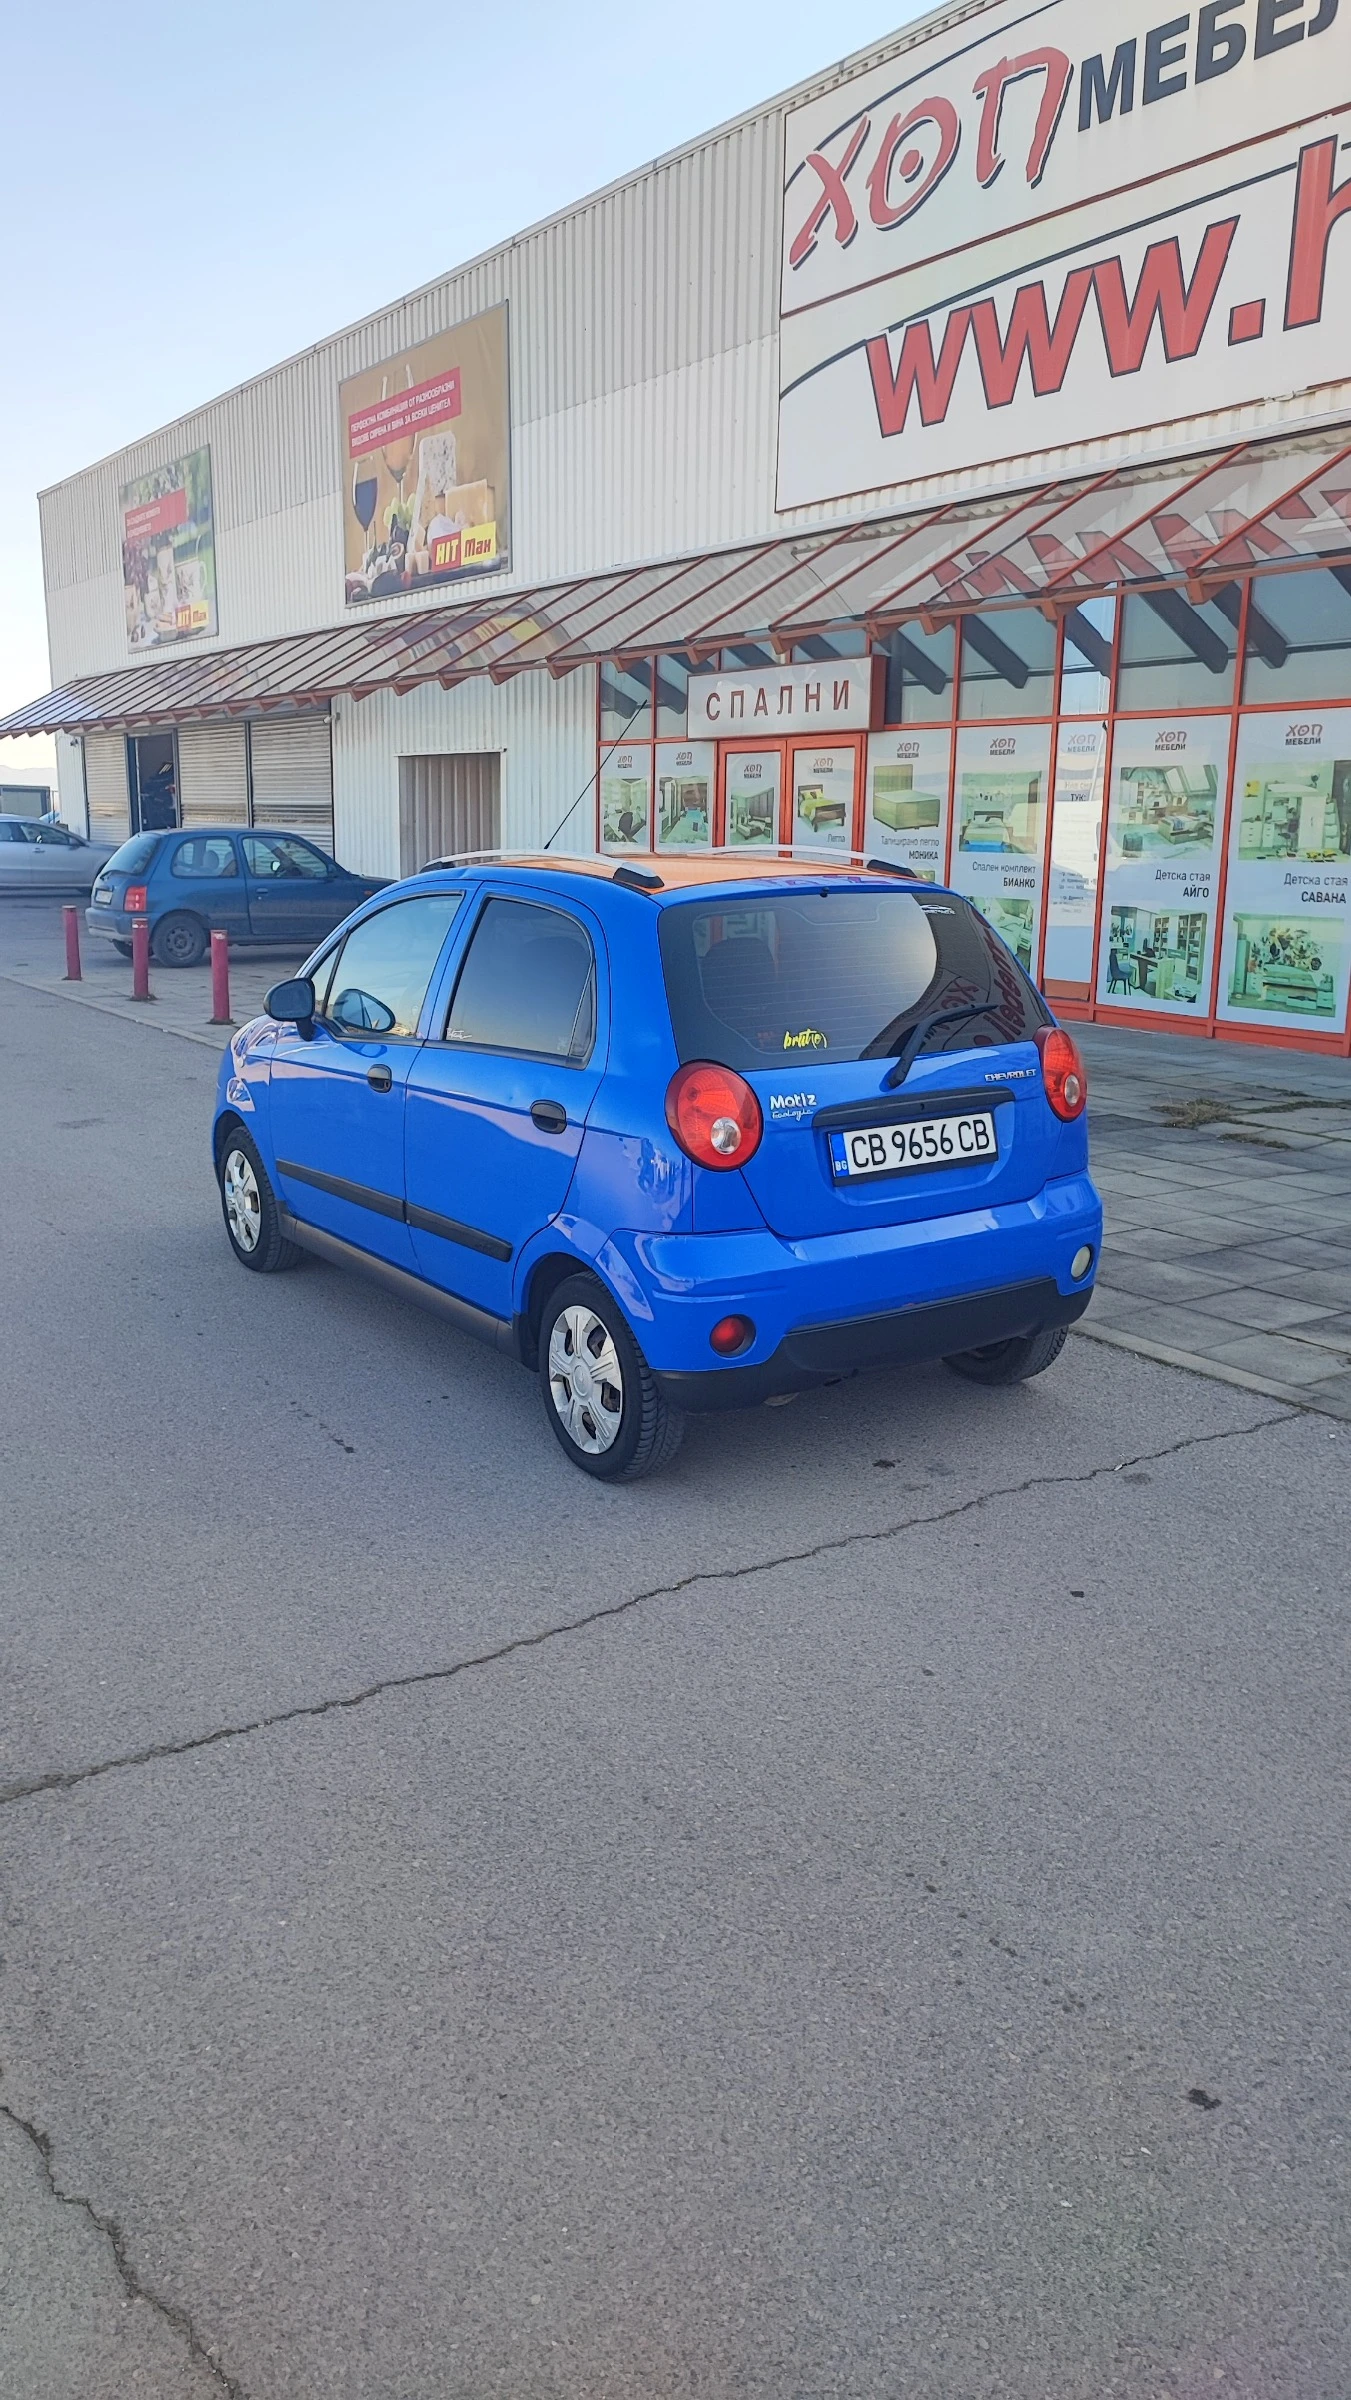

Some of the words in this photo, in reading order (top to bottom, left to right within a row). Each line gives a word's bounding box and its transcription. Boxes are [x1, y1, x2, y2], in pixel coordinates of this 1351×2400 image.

[788, 46, 1074, 270] ХОП
[408, 397, 416, 407] ОТ
[705, 679, 850, 721] СПАЛНИ
[1285, 723, 1323, 737] ХОП
[1155, 731, 1187, 743] ХОП
[1285, 737, 1321, 746] МЕБЕЛИ
[897, 742, 920, 752] ХОП
[990, 738, 1016, 749] ХОП
[1155, 743, 1186, 751] МЕБЕЛИ
[743, 763, 762, 773] ХОП
[813, 757, 834, 767] ХОП
[908, 850, 938, 860] МОНИКА
[972, 861, 999, 872] Спален
[1000, 864, 1036, 874] комплект
[1155, 869, 1187, 881] Детска
[1189, 872, 1211, 882] стая
[1284, 873, 1321, 885] Детска
[1324, 875, 1348, 886] стая
[1003, 877, 1035, 888] БИАНКО
[1183, 884, 1210, 898] АЙГО
[1301, 891, 1347, 904] САВАНА
[984, 1068, 1037, 1082] CHEVROLET
[770, 1092, 817, 1110] Matiz
[851, 1133, 887, 1168] CB
[891, 1123, 954, 1162] 9656
[958, 1119, 990, 1152] CB
[835, 1160, 848, 1171] BG
